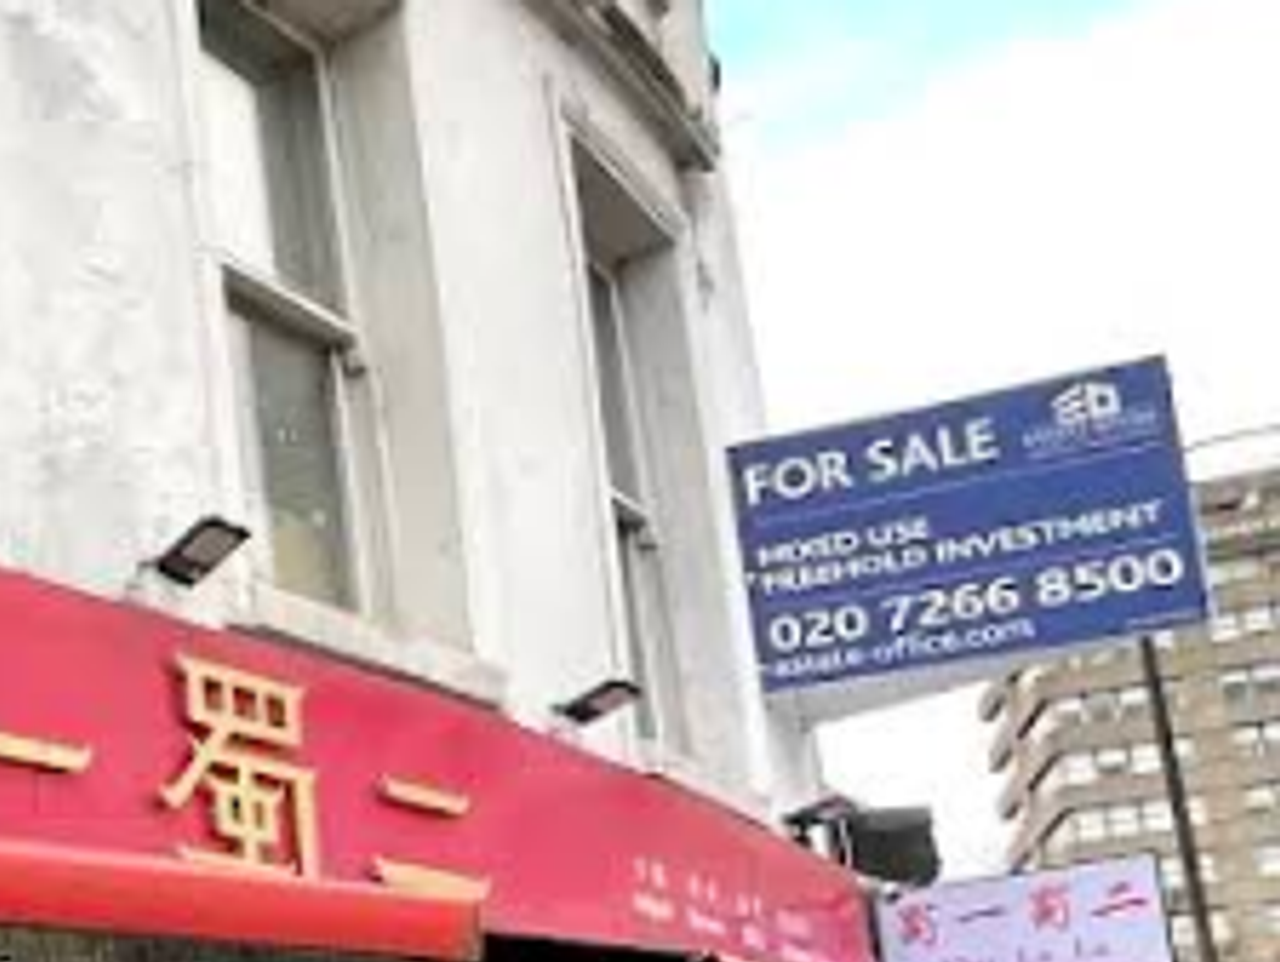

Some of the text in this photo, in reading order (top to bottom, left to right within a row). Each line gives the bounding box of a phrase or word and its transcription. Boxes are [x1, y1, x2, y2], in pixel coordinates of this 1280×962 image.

[743, 451, 854, 506] FOR
[867, 417, 1000, 484] SALE
[866, 516, 929, 547] USE
[937, 499, 1164, 564] INVESTMENT
[769, 547, 1185, 652] 020 7266 8500
